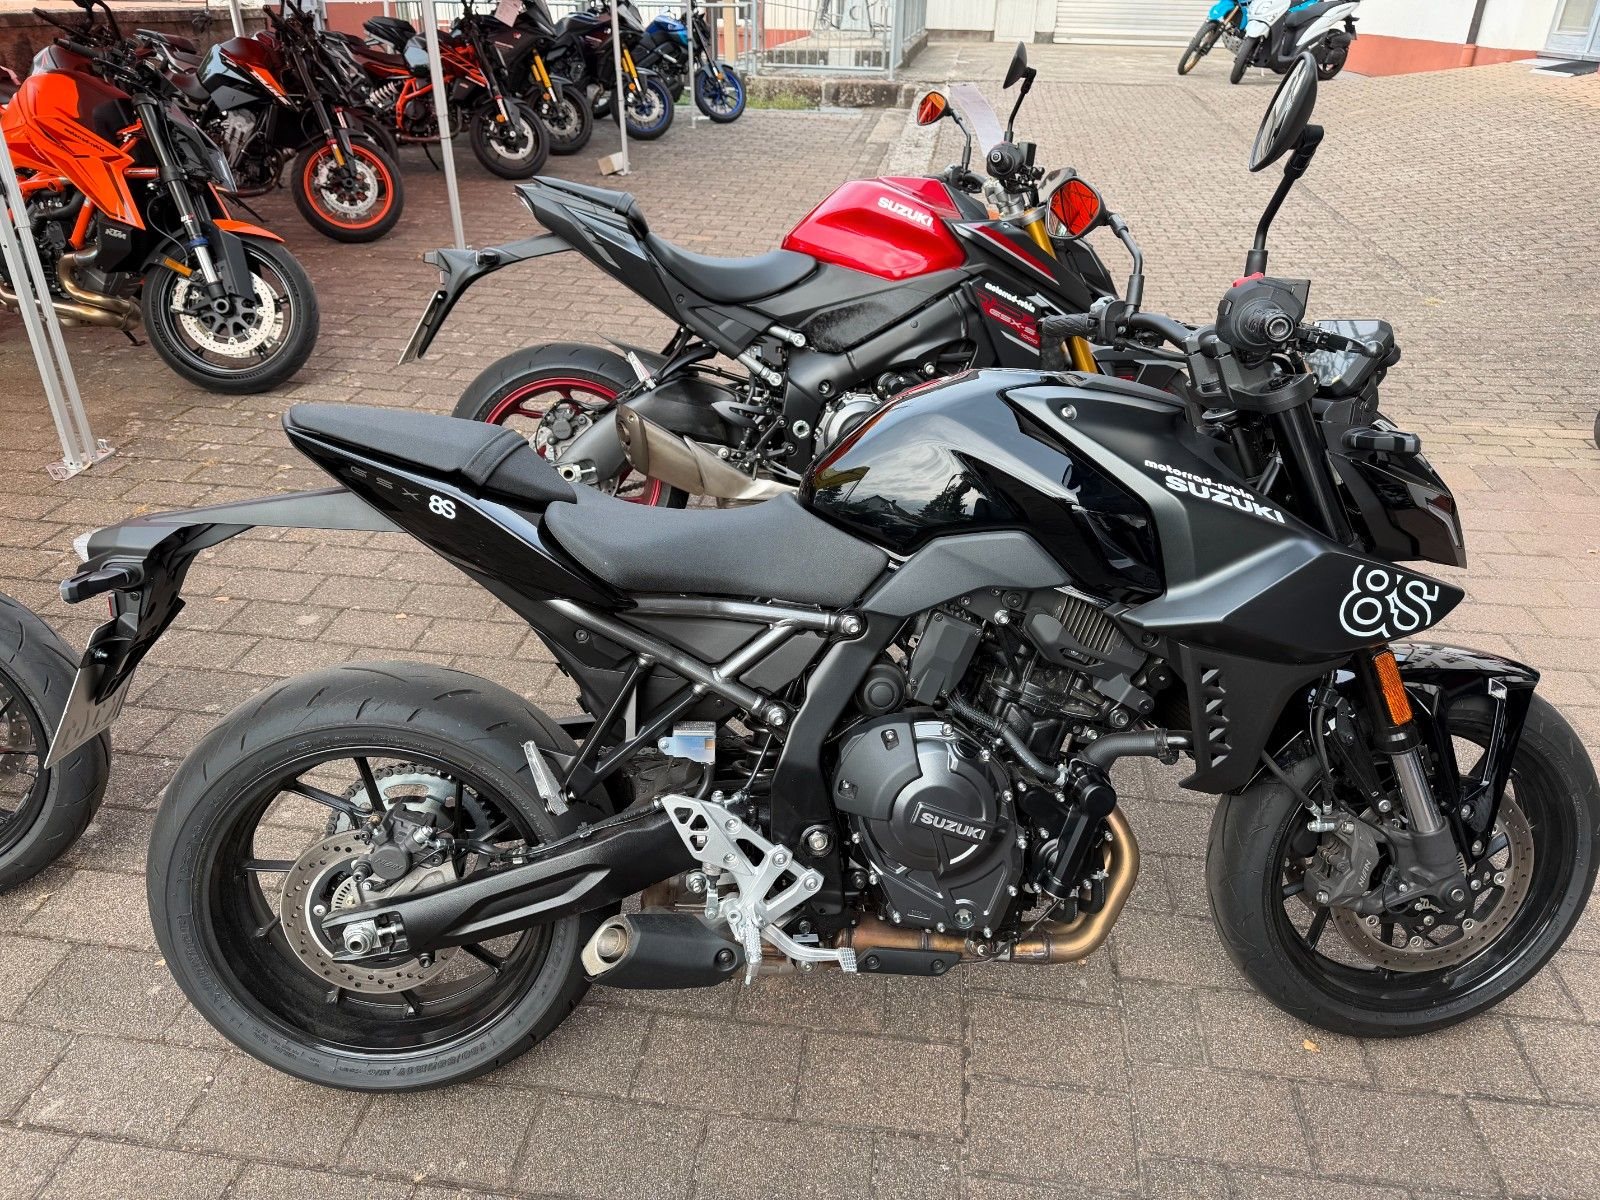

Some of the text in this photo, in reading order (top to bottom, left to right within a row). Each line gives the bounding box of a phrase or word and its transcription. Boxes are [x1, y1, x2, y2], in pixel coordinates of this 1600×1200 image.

[877, 196, 934, 228] SUZUKI
[105, 228, 127, 240] KTM
[989, 308, 1036, 336] GSX-S
[1021, 333, 1038, 345] 1000
[1144, 459, 1255, 501] motorrad-rubin
[428, 494, 457, 520] 8S
[1165, 475, 1286, 524] SUZUKI
[919, 811, 987, 841] SUZUKI
